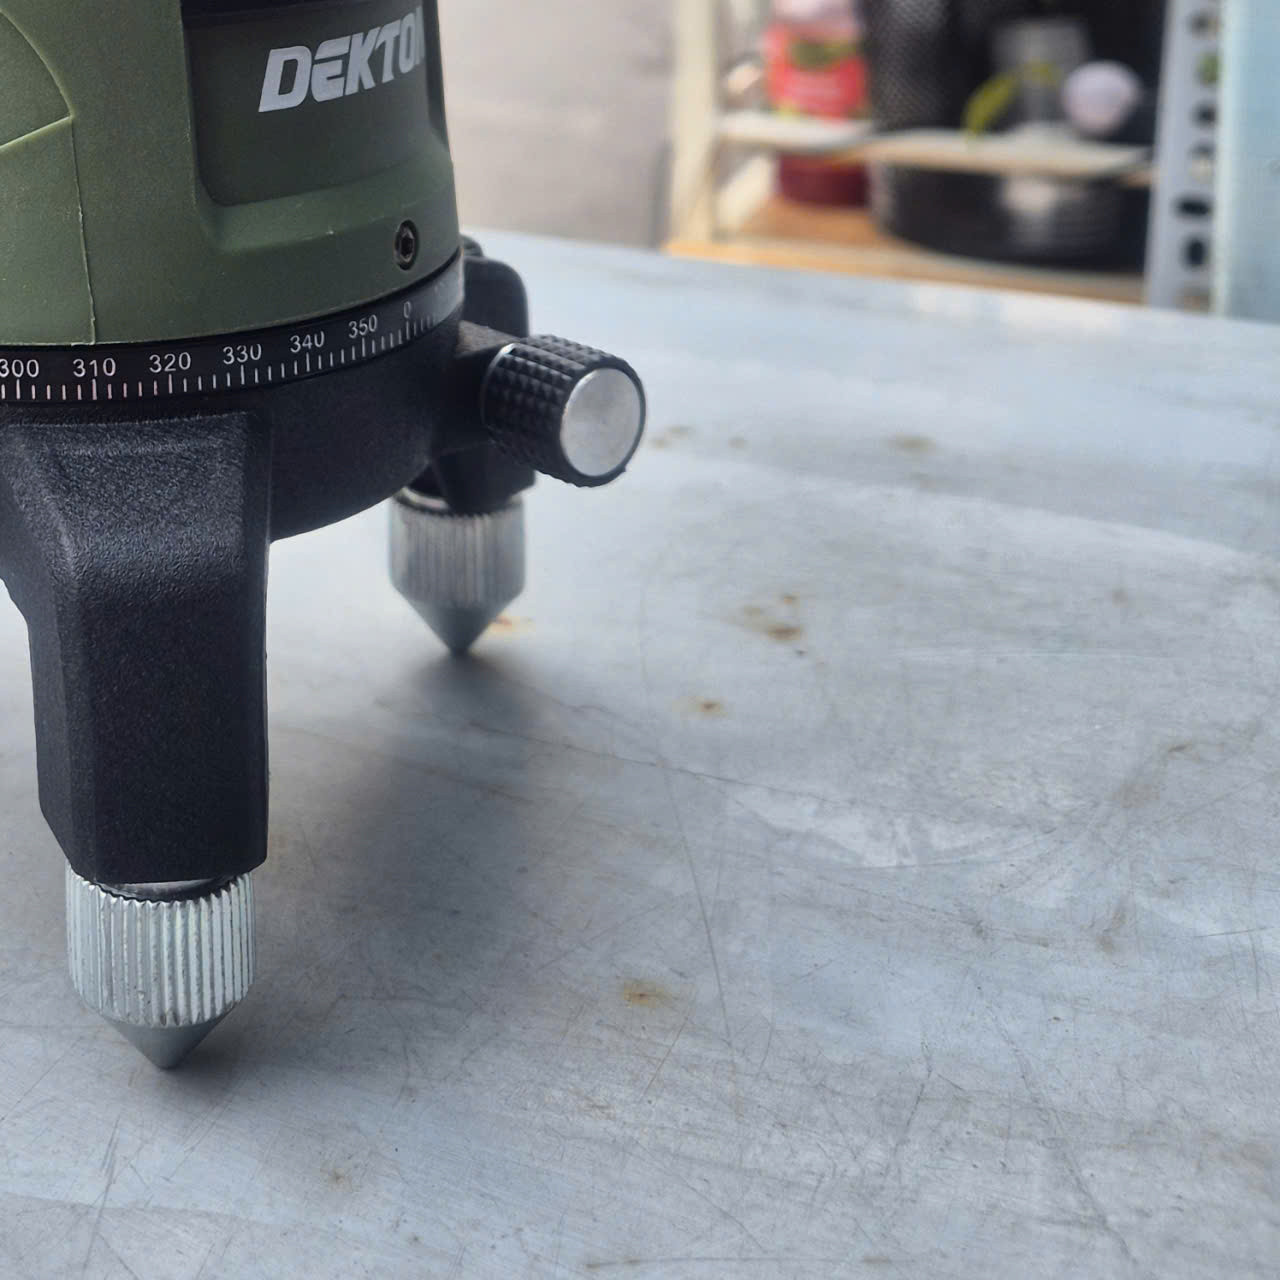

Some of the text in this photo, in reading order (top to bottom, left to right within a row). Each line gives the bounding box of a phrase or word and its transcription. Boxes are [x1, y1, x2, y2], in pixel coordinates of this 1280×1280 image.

[73, 358, 116, 378] 310
[149, 352, 191, 373] 320
[223, 343, 262, 365] 330
[290, 331, 325, 353] 340
[348, 314, 378, 339] 350
